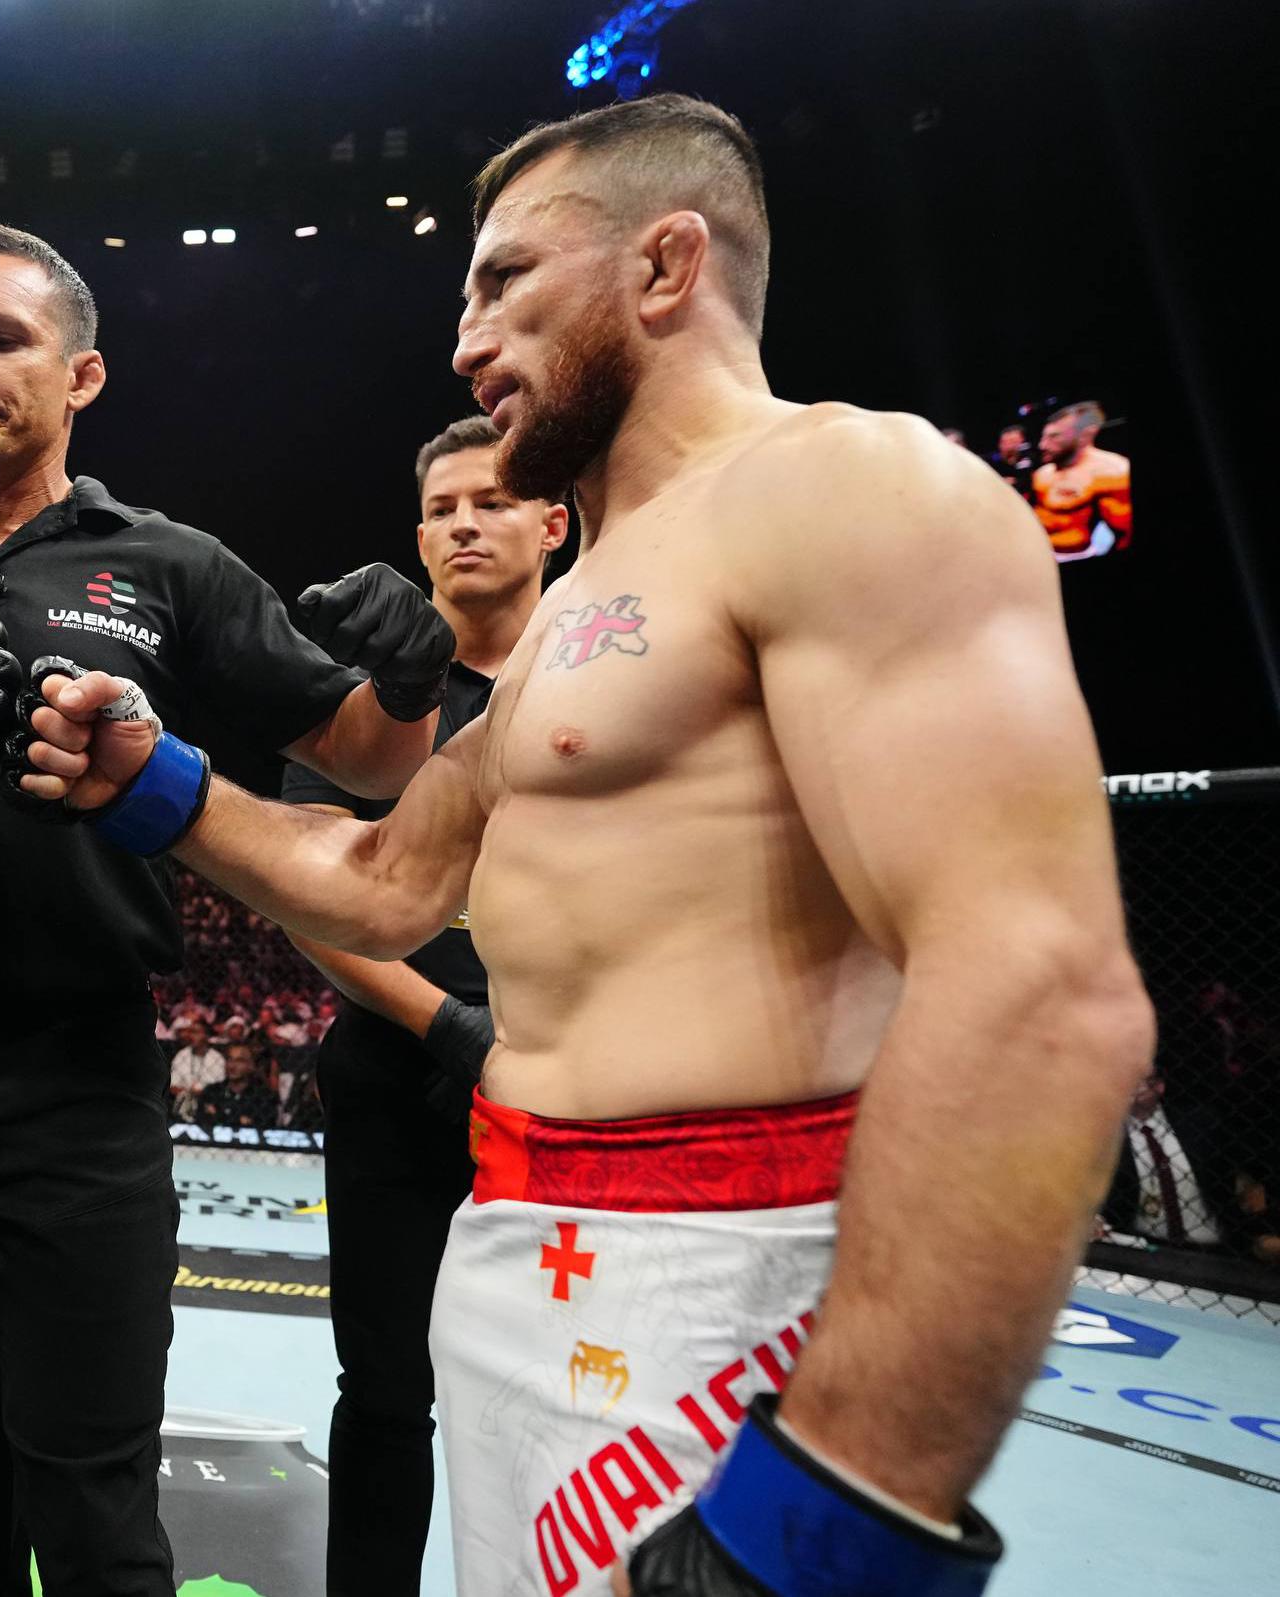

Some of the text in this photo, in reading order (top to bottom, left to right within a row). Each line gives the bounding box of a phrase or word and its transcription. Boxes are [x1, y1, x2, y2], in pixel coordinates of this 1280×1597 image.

[48, 608, 162, 647] UAEMMAF
[62, 621, 83, 630] MIXED
[83, 623, 111, 637] MARTIAL
[111, 632, 128, 642] ARTS
[128, 637, 158, 657] FEDERATION
